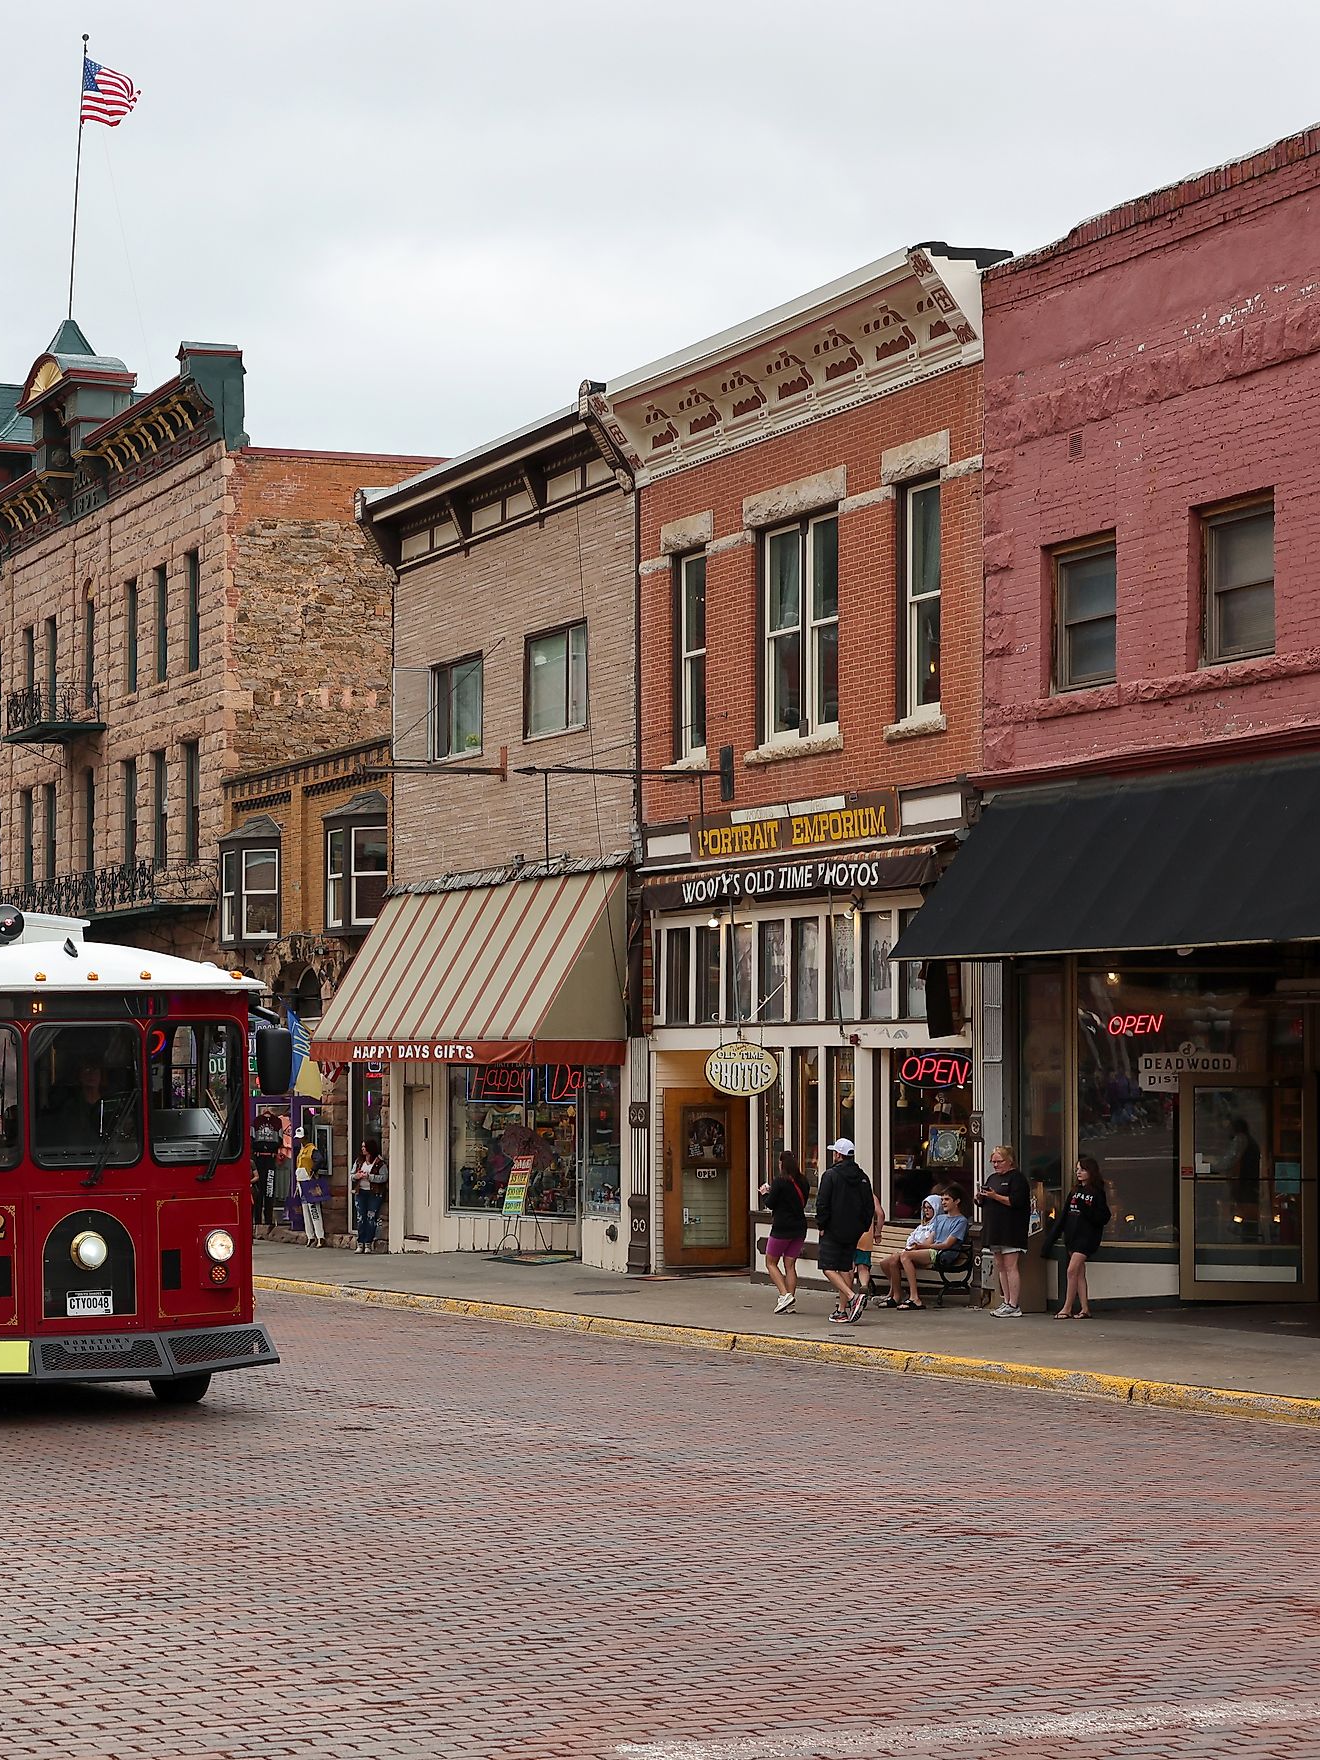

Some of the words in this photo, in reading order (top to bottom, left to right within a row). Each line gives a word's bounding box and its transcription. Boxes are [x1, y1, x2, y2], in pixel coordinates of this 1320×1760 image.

[698, 820, 779, 857] PORTRAIT
[791, 805, 888, 845] EMPORIUM
[744, 869, 774, 895] OLD
[779, 864, 813, 889] TIME
[817, 861, 879, 888] PHOTOS
[1108, 1014, 1164, 1035] OPEN
[353, 1045, 393, 1059] HAPPY
[398, 1045, 430, 1059] DAYS
[434, 1045, 474, 1059] GIFTS
[716, 1051, 738, 1060] OLD
[741, 1051, 764, 1060] TIME
[902, 1056, 969, 1084] OPEN
[1144, 1057, 1231, 1070] DEADWOOD
[552, 1063, 585, 1100] Da
[709, 1061, 772, 1092] PHOTOS
[697, 1170, 716, 1179] OPEN
[69, 1297, 109, 1309] CTY0048
[63, 1337, 131, 1346] HOMETOWN
